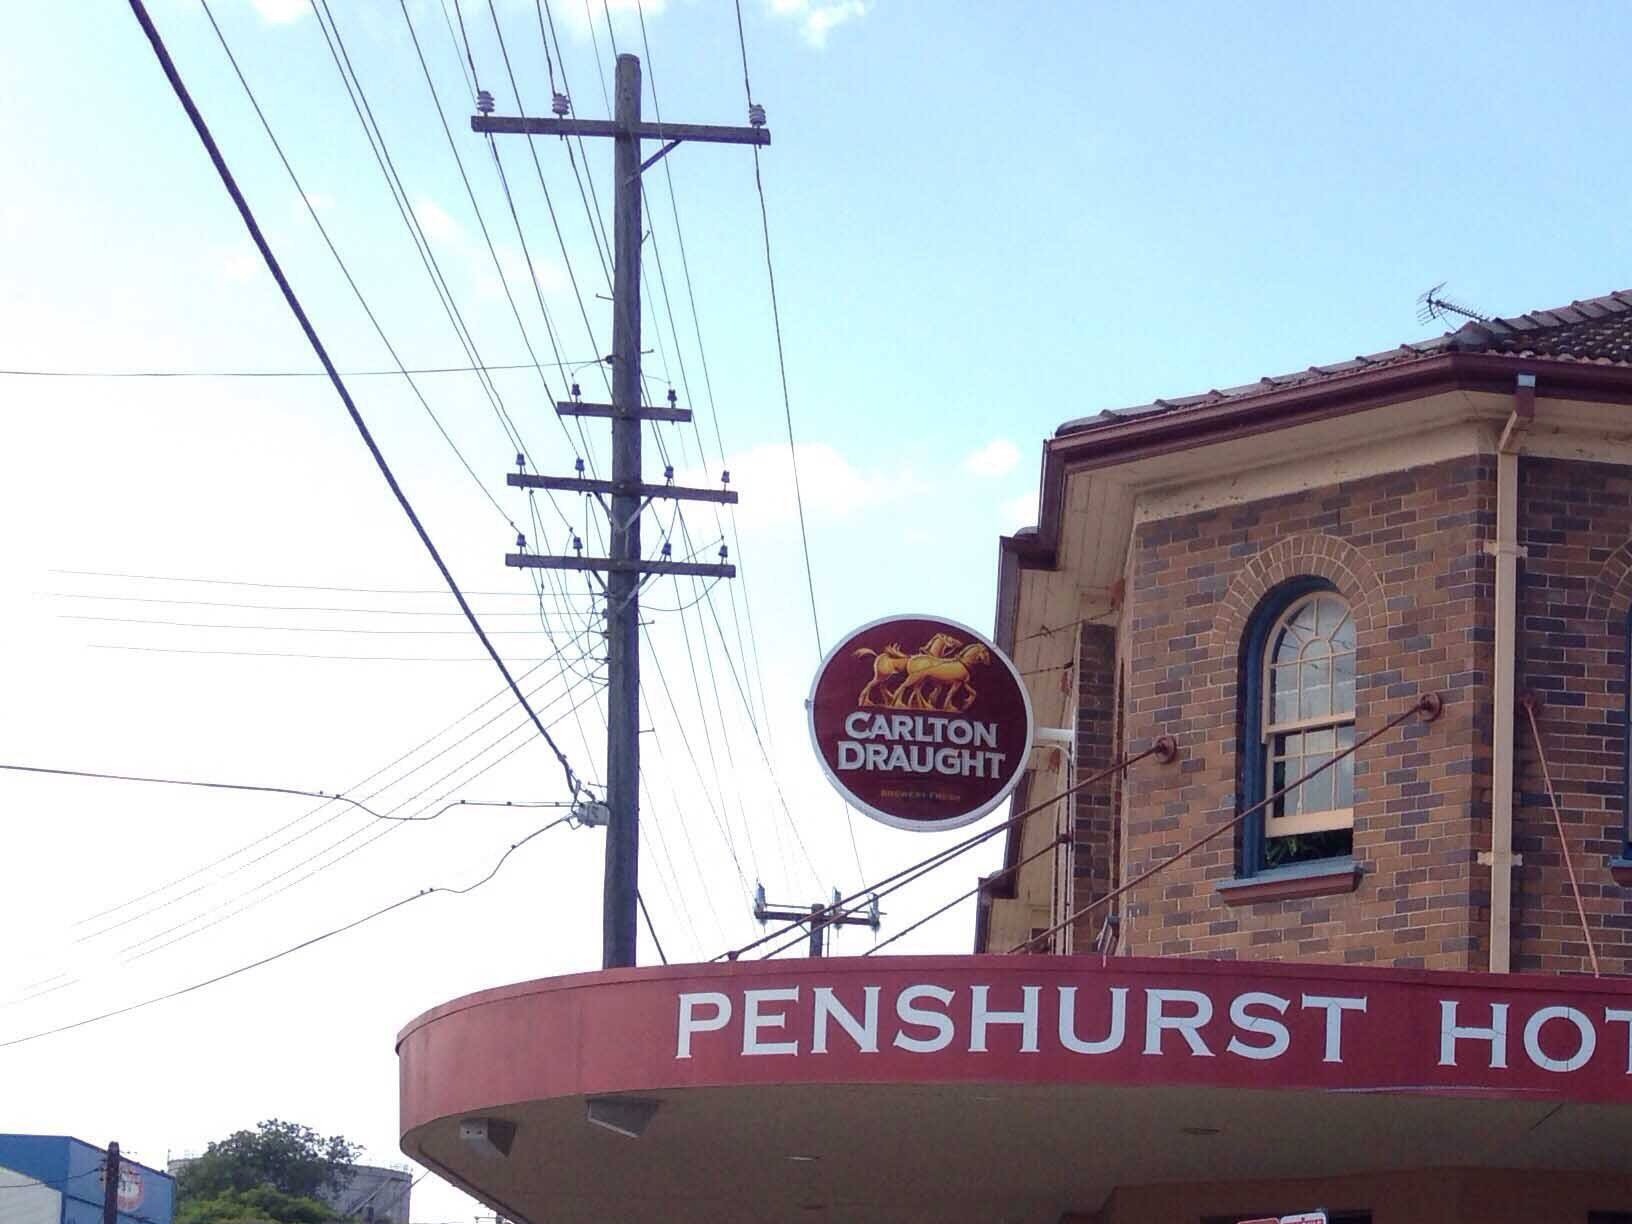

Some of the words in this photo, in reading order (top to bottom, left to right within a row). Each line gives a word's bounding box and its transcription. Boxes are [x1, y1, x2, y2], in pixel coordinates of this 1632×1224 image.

[845, 711, 999, 749] CARLTON
[837, 740, 1006, 779] DRAUGHT
[674, 984, 1368, 1062] PENSHURST
